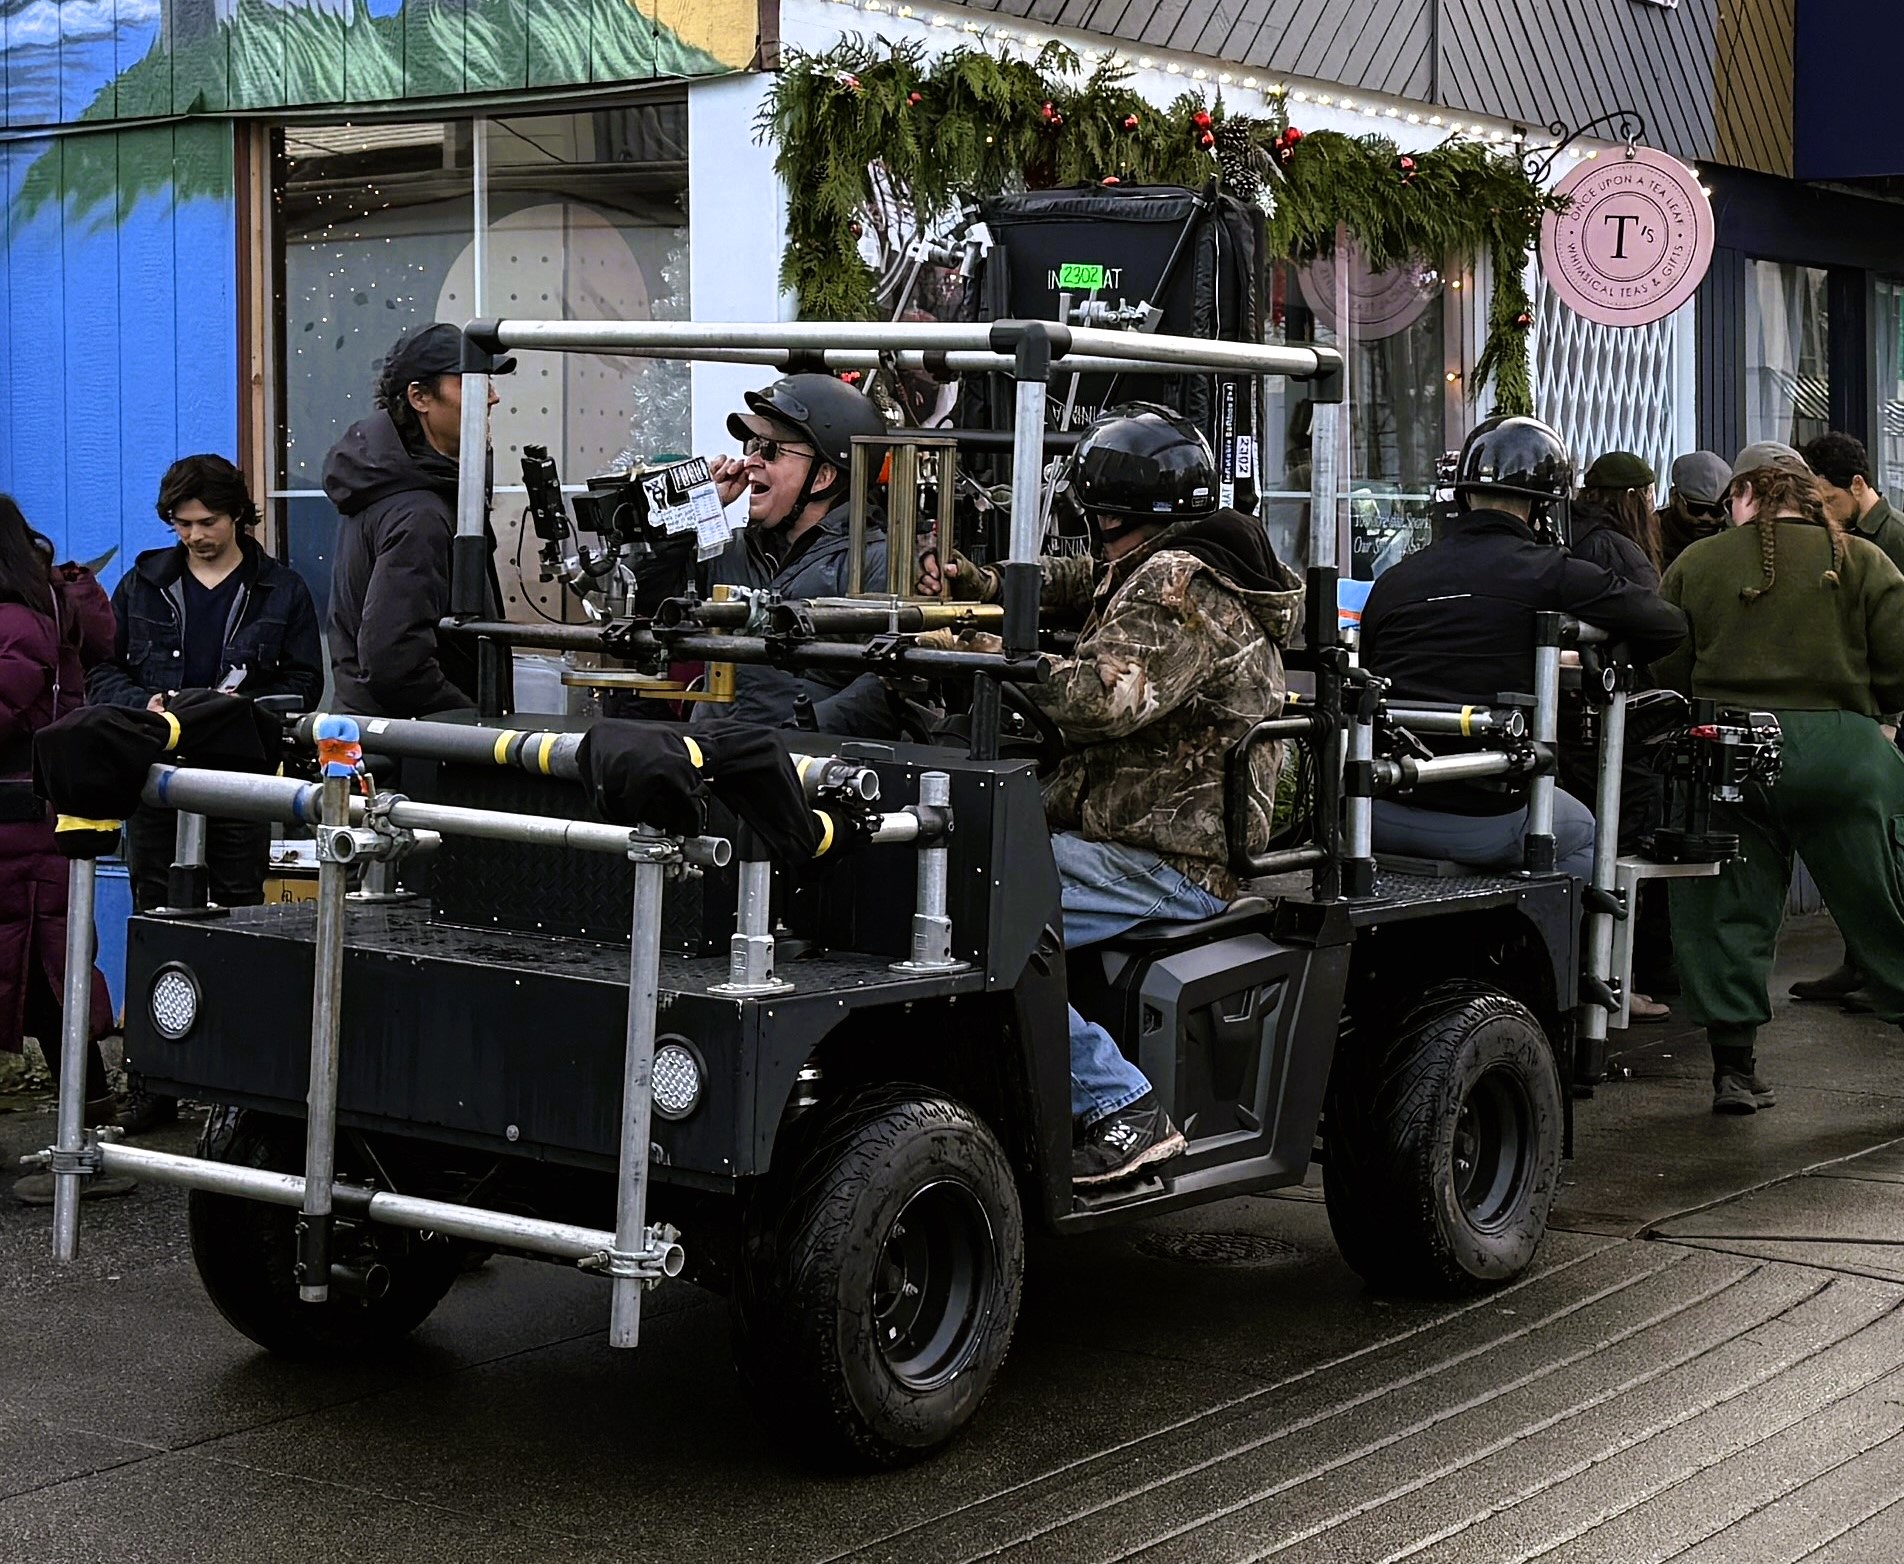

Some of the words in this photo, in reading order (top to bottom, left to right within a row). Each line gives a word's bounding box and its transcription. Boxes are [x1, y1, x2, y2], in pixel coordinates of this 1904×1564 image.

[1570, 187, 1598, 222] ONCE
[1598, 174, 1633, 191] UPON
[1636, 176, 1644, 185] A
[1648, 179, 1667, 199] TEA
[1666, 197, 1685, 225] LEAF
[1064, 266, 1099, 285] 2302
[1567, 242, 1615, 298] WHIMSICAL
[1620, 283, 1648, 298] TEAS
[1651, 277, 1661, 287] &
[1661, 244, 1685, 278] GIFTS
